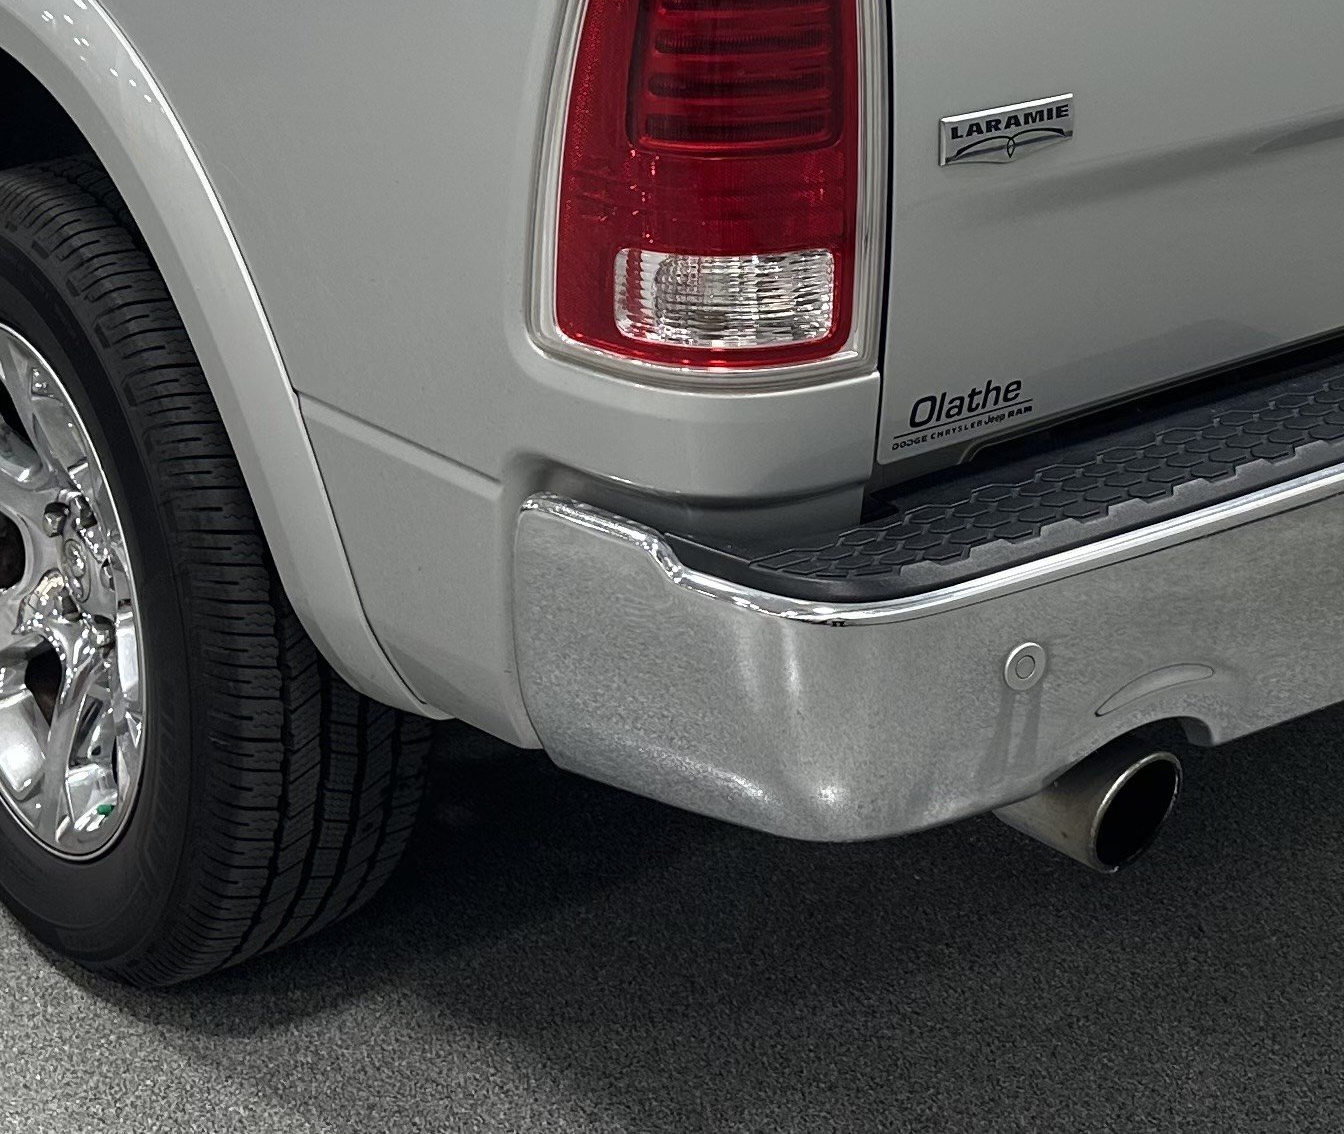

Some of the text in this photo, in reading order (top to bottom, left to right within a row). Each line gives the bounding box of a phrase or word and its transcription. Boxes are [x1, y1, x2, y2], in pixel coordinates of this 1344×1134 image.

[950, 104, 1069, 140] LARAMIE
[909, 379, 1022, 429] Olathe
[891, 405, 1033, 451] DODGE CHRYSLER Jeep RAM
